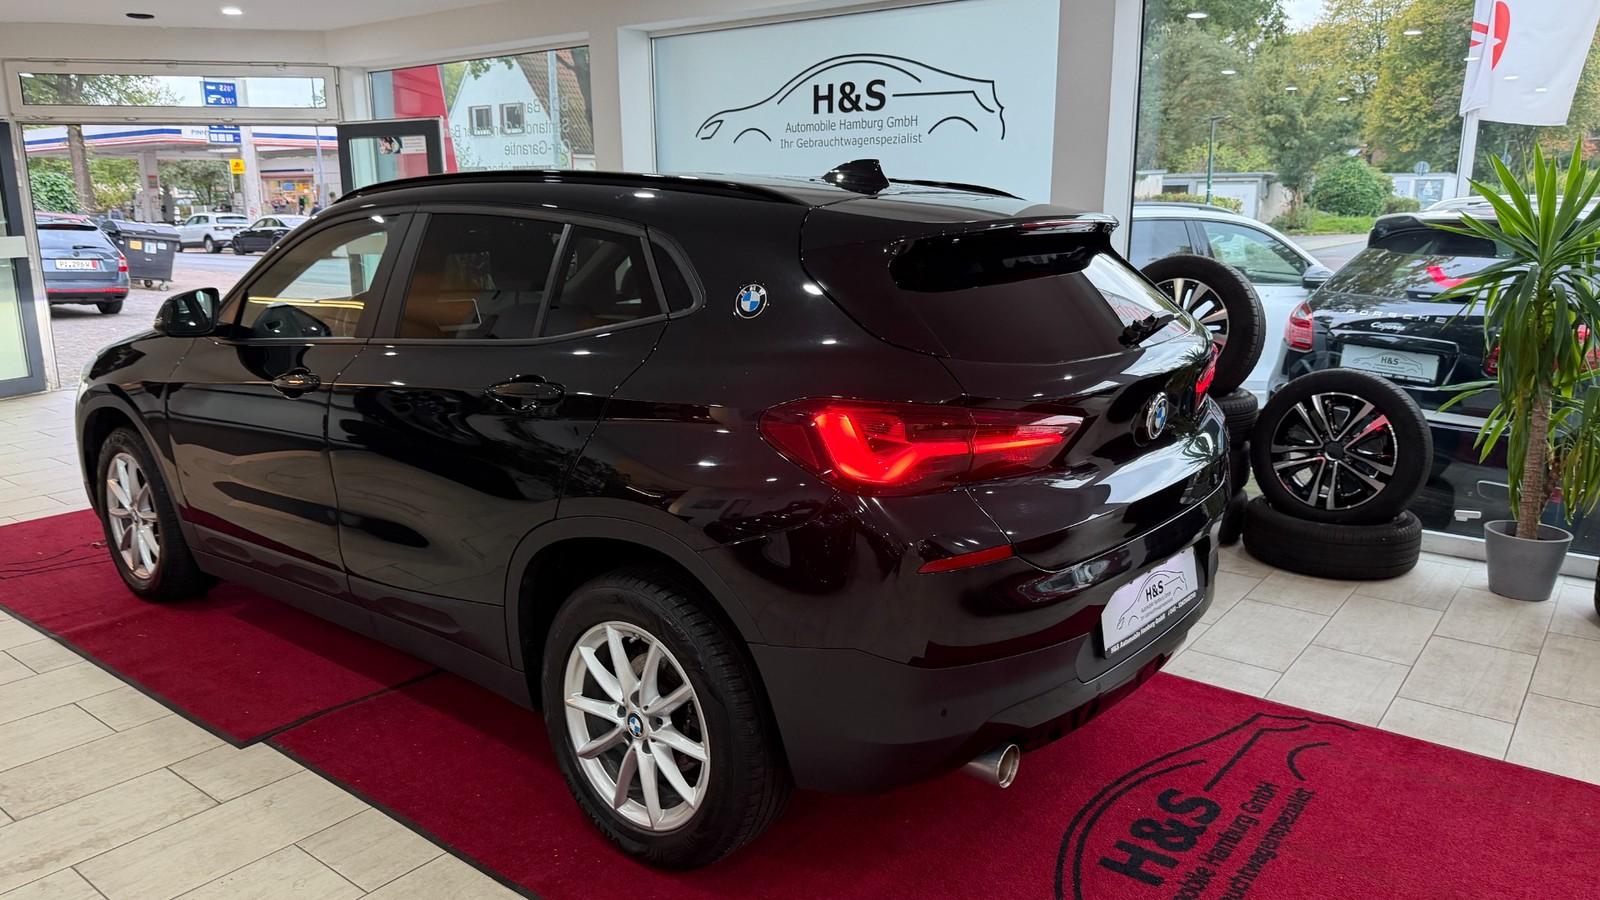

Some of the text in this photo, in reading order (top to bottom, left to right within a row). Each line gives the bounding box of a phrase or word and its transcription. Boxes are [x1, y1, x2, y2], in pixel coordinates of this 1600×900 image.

[813, 79, 886, 114] H&S
[785, 115, 918, 133] Automobile Hamburg GmbH
[780, 133, 922, 149] Ihr Gebrauchtwagenspezialist
[1346, 309, 1448, 324] PORSCHE
[1381, 356, 1399, 366] H&S
[1145, 580, 1164, 602] H&S
[1098, 788, 1222, 887] H&S
[1172, 780, 1281, 900] obile Hamburg GmbH
[1217, 787, 1315, 900] uchtwagenspezialist
